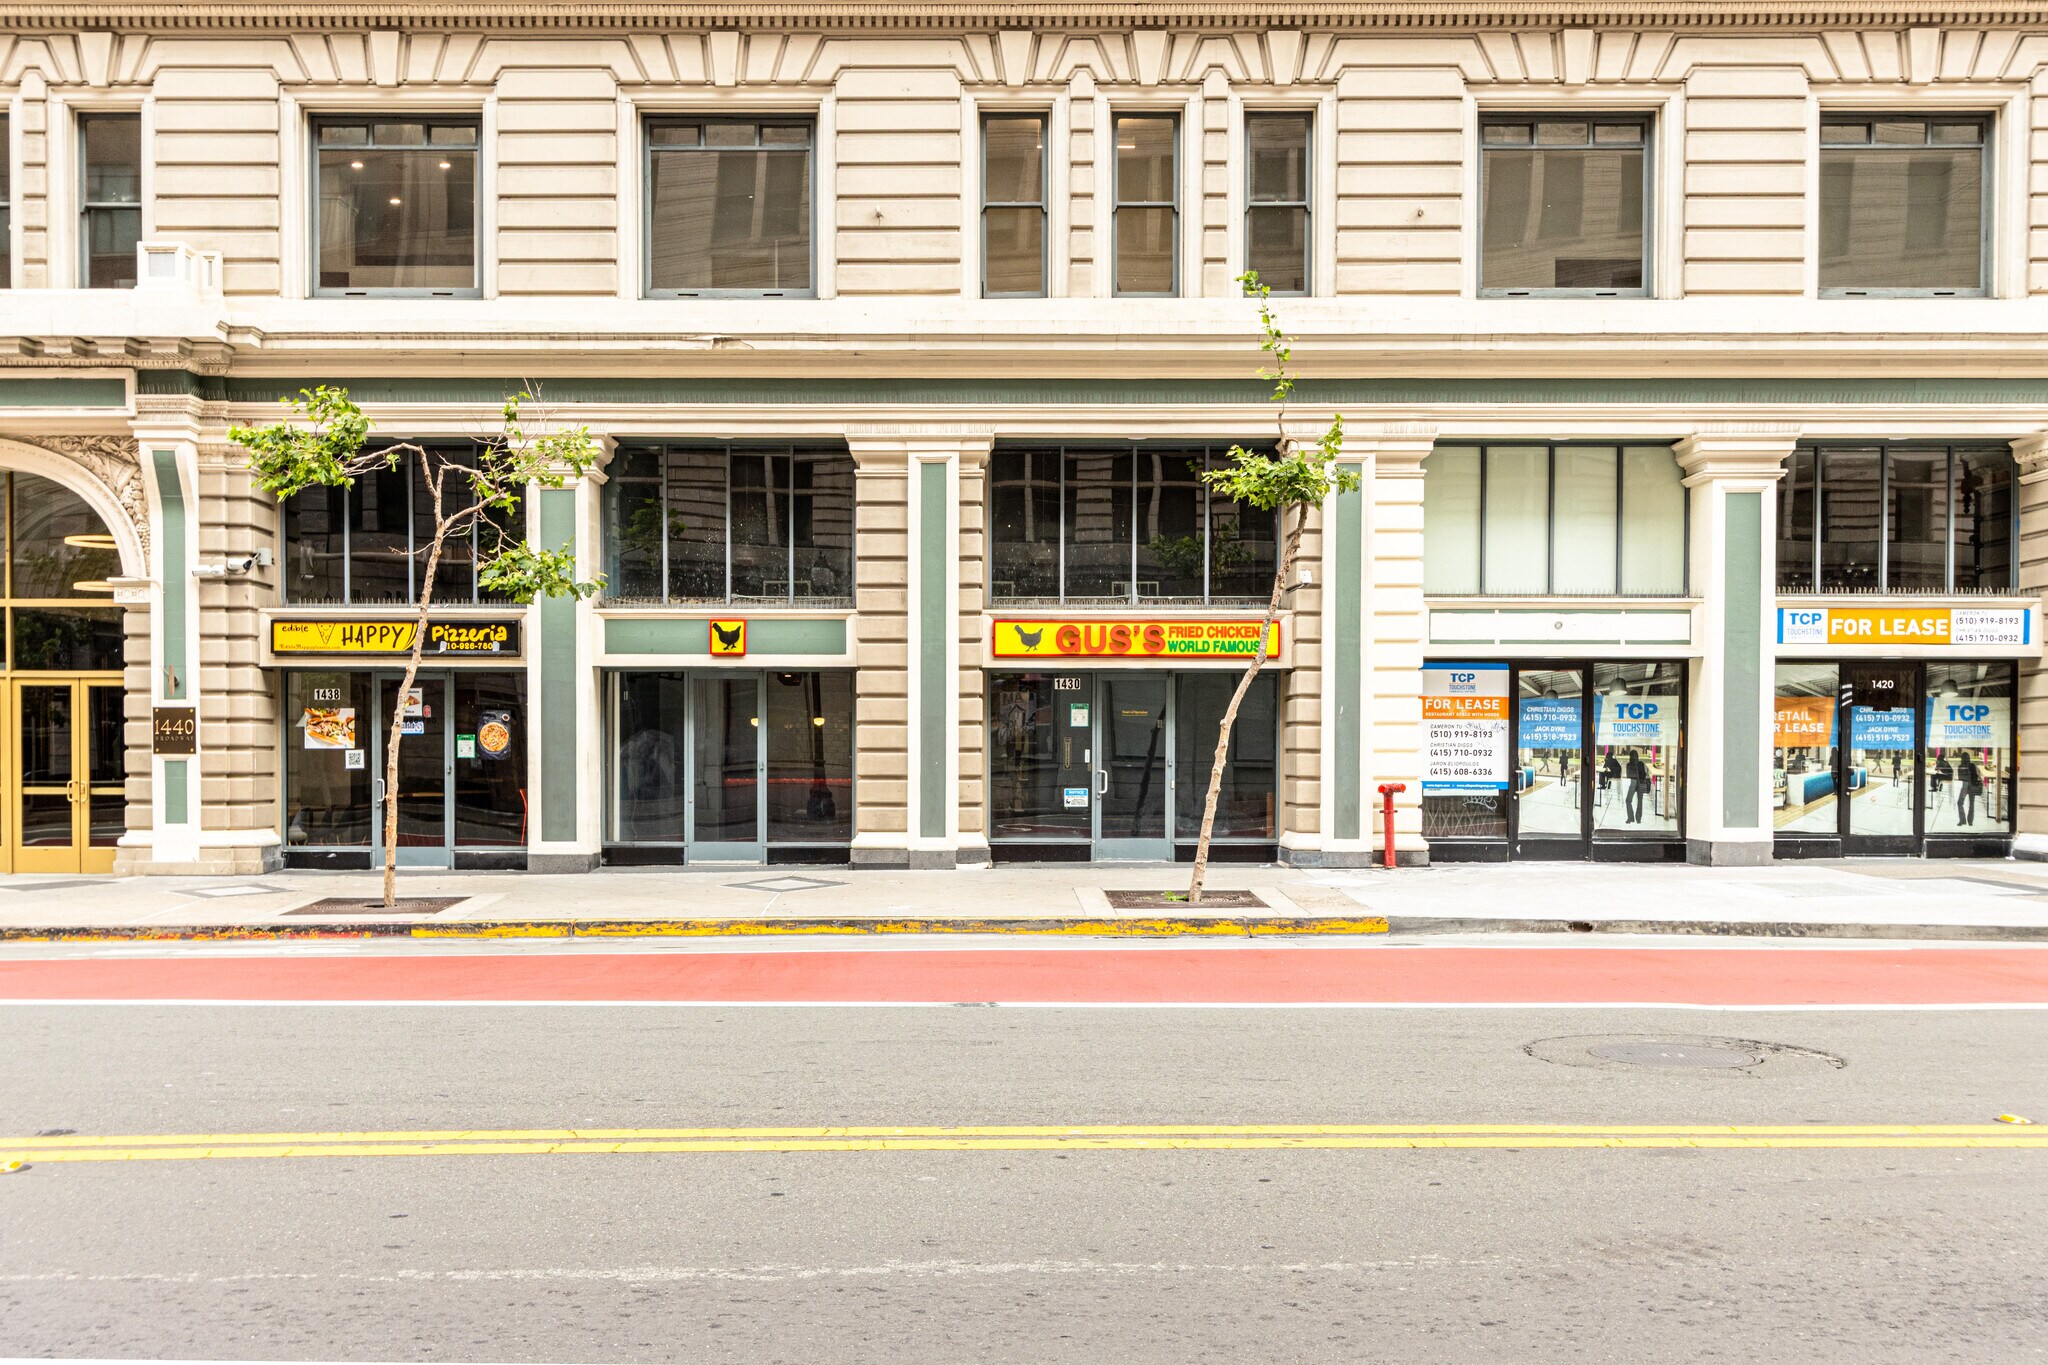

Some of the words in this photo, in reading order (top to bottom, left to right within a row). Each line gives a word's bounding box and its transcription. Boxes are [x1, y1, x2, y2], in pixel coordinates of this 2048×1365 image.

[1790, 613, 1822, 625] TCP
[1956, 617, 1977, 625] (510)
[282, 624, 309, 632] edible
[1168, 626, 1204, 638] FRIED
[1206, 626, 1260, 638] CHICKEN
[1787, 628, 1823, 636] TOUCHSTONE
[1831, 618, 1872, 636] FOR
[1880, 618, 1949, 636] LEASE
[341, 625, 405, 648] HAPPY
[431, 624, 508, 642] Pizzeria
[1956, 634, 1977, 642] (415)
[1055, 624, 1166, 653] GUS'S
[1167, 640, 1210, 653] WORLD
[1450, 673, 1475, 683] TCP
[1056, 679, 1080, 689] 1430
[1872, 680, 1894, 689] 1420
[315, 689, 339, 699] 1438
[1425, 699, 1451, 710] FOR
[1456, 699, 1500, 710] LEASE
[1616, 703, 1658, 719] TCP
[1948, 705, 1990, 721] TCP
[1523, 714, 1542, 722] (415)
[1855, 714, 1875, 722] (415)
[1876, 714, 1910, 722] 710-0932
[155, 719, 194, 735] 1440
[1613, 723, 1660, 732] TOUCHSTONE
[1785, 723, 1825, 733] LEASE
[1944, 725, 1991, 734] TOUCHSTONE
[1430, 730, 1452, 739] (510)
[1454, 730, 1493, 738] 919-8193
[1523, 733, 1542, 741] (415)
[1543, 733, 1577, 741] 518-7523
[1855, 734, 1875, 742] (415)
[1876, 734, 1910, 742] 518-7523
[1430, 749, 1452, 757] (415)
[1454, 749, 1493, 757] 710-0932
[1430, 768, 1452, 776] (415)
[1453, 768, 1493, 776] 608-6336
